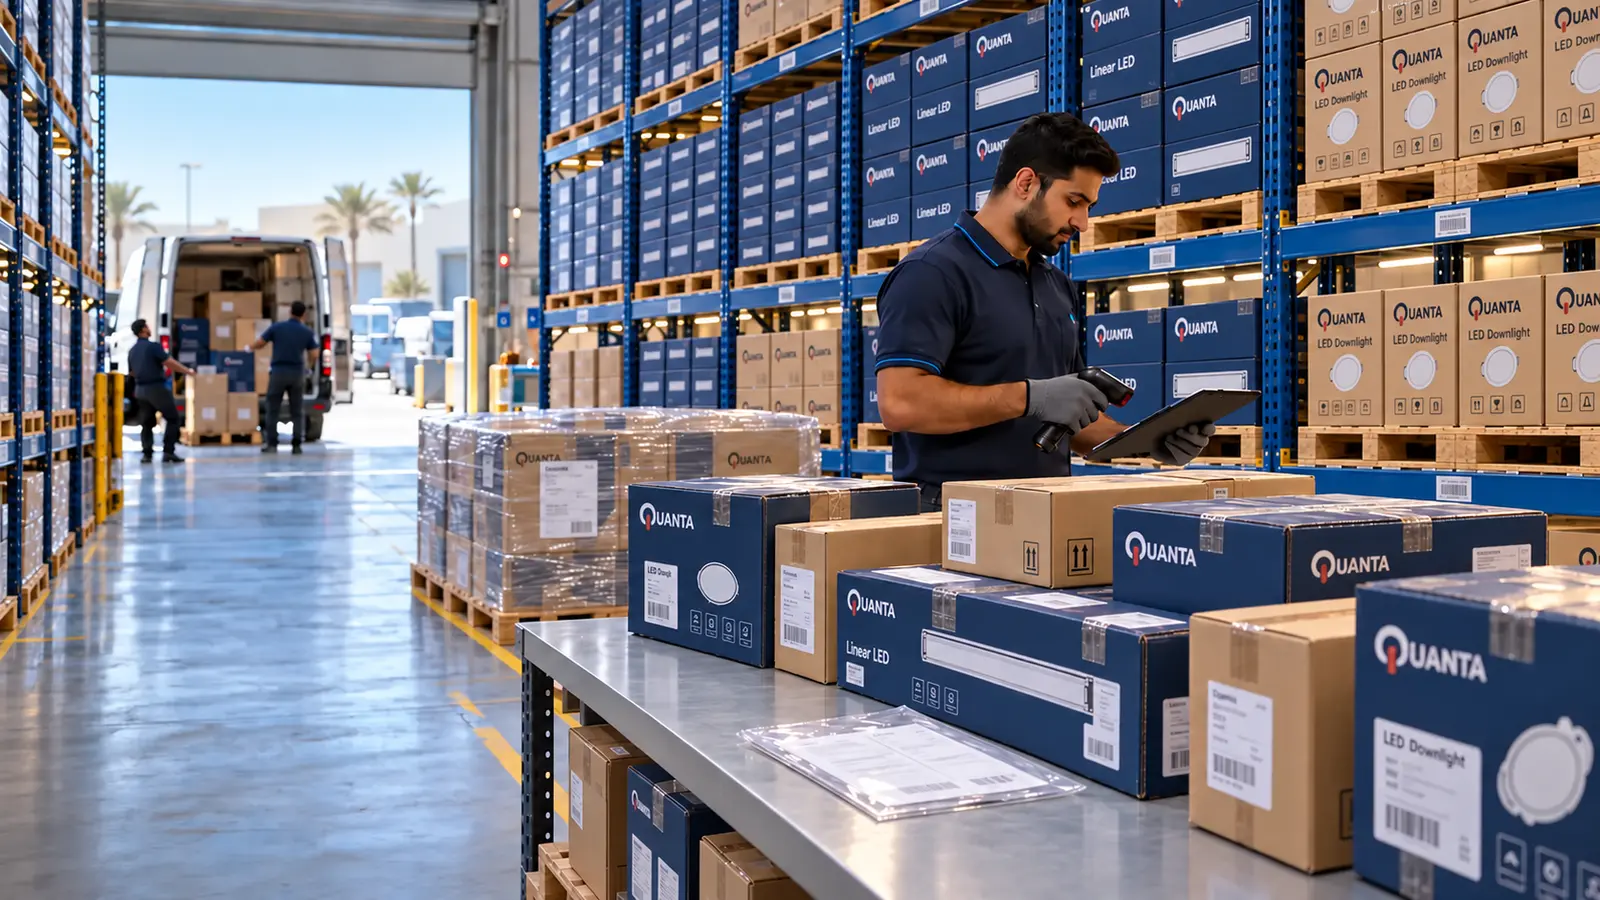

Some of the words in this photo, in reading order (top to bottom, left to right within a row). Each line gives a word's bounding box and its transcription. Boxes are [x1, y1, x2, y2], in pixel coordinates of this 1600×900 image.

[1090, 6, 1130, 32] QUANTA
[1554, 6, 1600, 33] QUAN
[976, 32, 1012, 58] QUANTA
[1467, 25, 1519, 53] QUANTA
[1554, 38, 1573, 52] LED
[916, 53, 948, 76] QUANTA
[1090, 61, 1116, 79] Linear
[1117, 55, 1135, 71] LED
[1391, 47, 1443, 74] QUANTA
[1467, 60, 1484, 73] LED
[1485, 49, 1528, 68] Downlight
[866, 71, 896, 94] QUANTA
[1314, 67, 1363, 93] QUANTA
[1391, 80, 1407, 93] LED
[1408, 71, 1447, 88] Downlight
[917, 104, 937, 120] Linear
[938, 101, 951, 115] LED
[1172, 94, 1217, 121] QUANTA
[1314, 98, 1330, 110] LED
[1331, 90, 1368, 106] Downlight
[868, 120, 887, 136] Linear
[888, 116, 901, 131] LED
[1089, 115, 1130, 134] QUANTA
[976, 138, 1009, 162] QUANT
[866, 166, 895, 187] QUANTA
[916, 153, 948, 176] QUANTA
[1120, 166, 1137, 181] LED
[868, 215, 886, 229] Linear
[887, 213, 900, 226] LED
[917, 205, 937, 219] Linear
[938, 203, 951, 215] LED
[1317, 308, 1366, 332] QUANTA
[1393, 302, 1443, 327] QUANTA
[1468, 296, 1521, 321] QUANTA
[1094, 324, 1133, 348] QUANTA
[1174, 317, 1219, 342] QUANTA
[1393, 334, 1408, 345] LED
[1410, 332, 1448, 345] Downlight
[1468, 329, 1485, 341] LED
[1487, 327, 1531, 340] Downlight
[1556, 323, 1575, 335] LED
[1317, 338, 1333, 349] LED
[1334, 336, 1373, 349] Downlight
[1120, 377, 1137, 391] ED
[516, 452, 562, 468] QUANTA
[728, 452, 772, 470] QUANTA
[639, 502, 695, 531] QUANTA
[1125, 530, 1197, 567] QUANTA
[1311, 550, 1390, 584] QUANTA
[847, 588, 896, 619] QUANTA
[846, 640, 871, 660] Linear
[873, 647, 890, 665] LED
[1374, 624, 1489, 684] QUANTA
[1383, 729, 1405, 749] LED
[1409, 739, 1466, 769] Downlight
